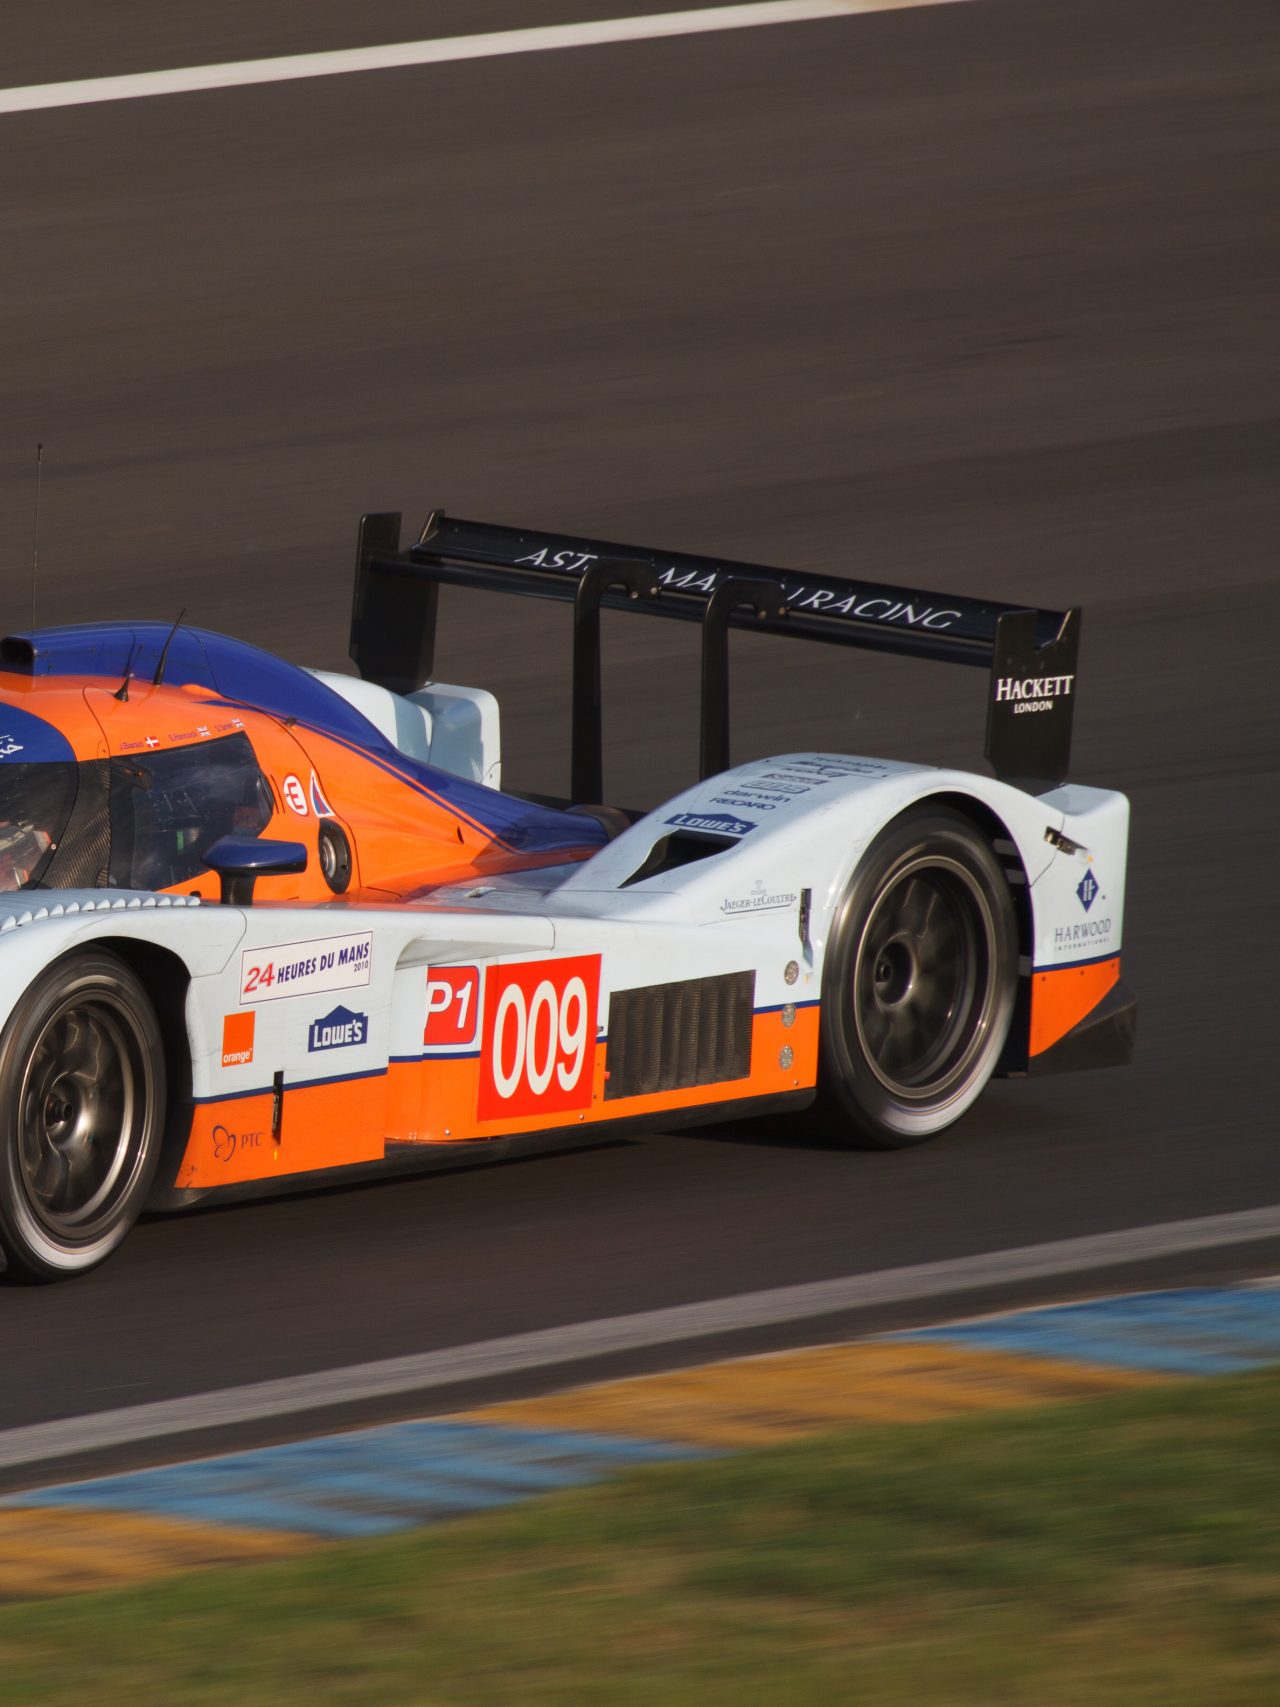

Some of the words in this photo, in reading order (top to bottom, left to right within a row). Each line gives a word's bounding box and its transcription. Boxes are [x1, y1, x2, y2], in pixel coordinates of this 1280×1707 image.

[514, 548, 599, 571] AST
[800, 590, 962, 628] RACING
[996, 675, 1074, 701] HACKETT
[1014, 700, 1053, 714] LONDON
[708, 797, 776, 810] RECARO
[723, 790, 792, 803] darwin
[673, 814, 747, 833] LOWE'S
[1054, 918, 1112, 943] HARWOOD
[243, 962, 275, 994] 24
[277, 957, 317, 984] HEURES
[319, 952, 335, 972] DU
[337, 941, 370, 966] MANS
[353, 960, 369, 973] 2010
[313, 1019, 363, 1048] LOWE'S
[492, 976, 588, 1098] 009
[223, 1050, 251, 1064] orange
[240, 1132, 263, 1149] PTC
